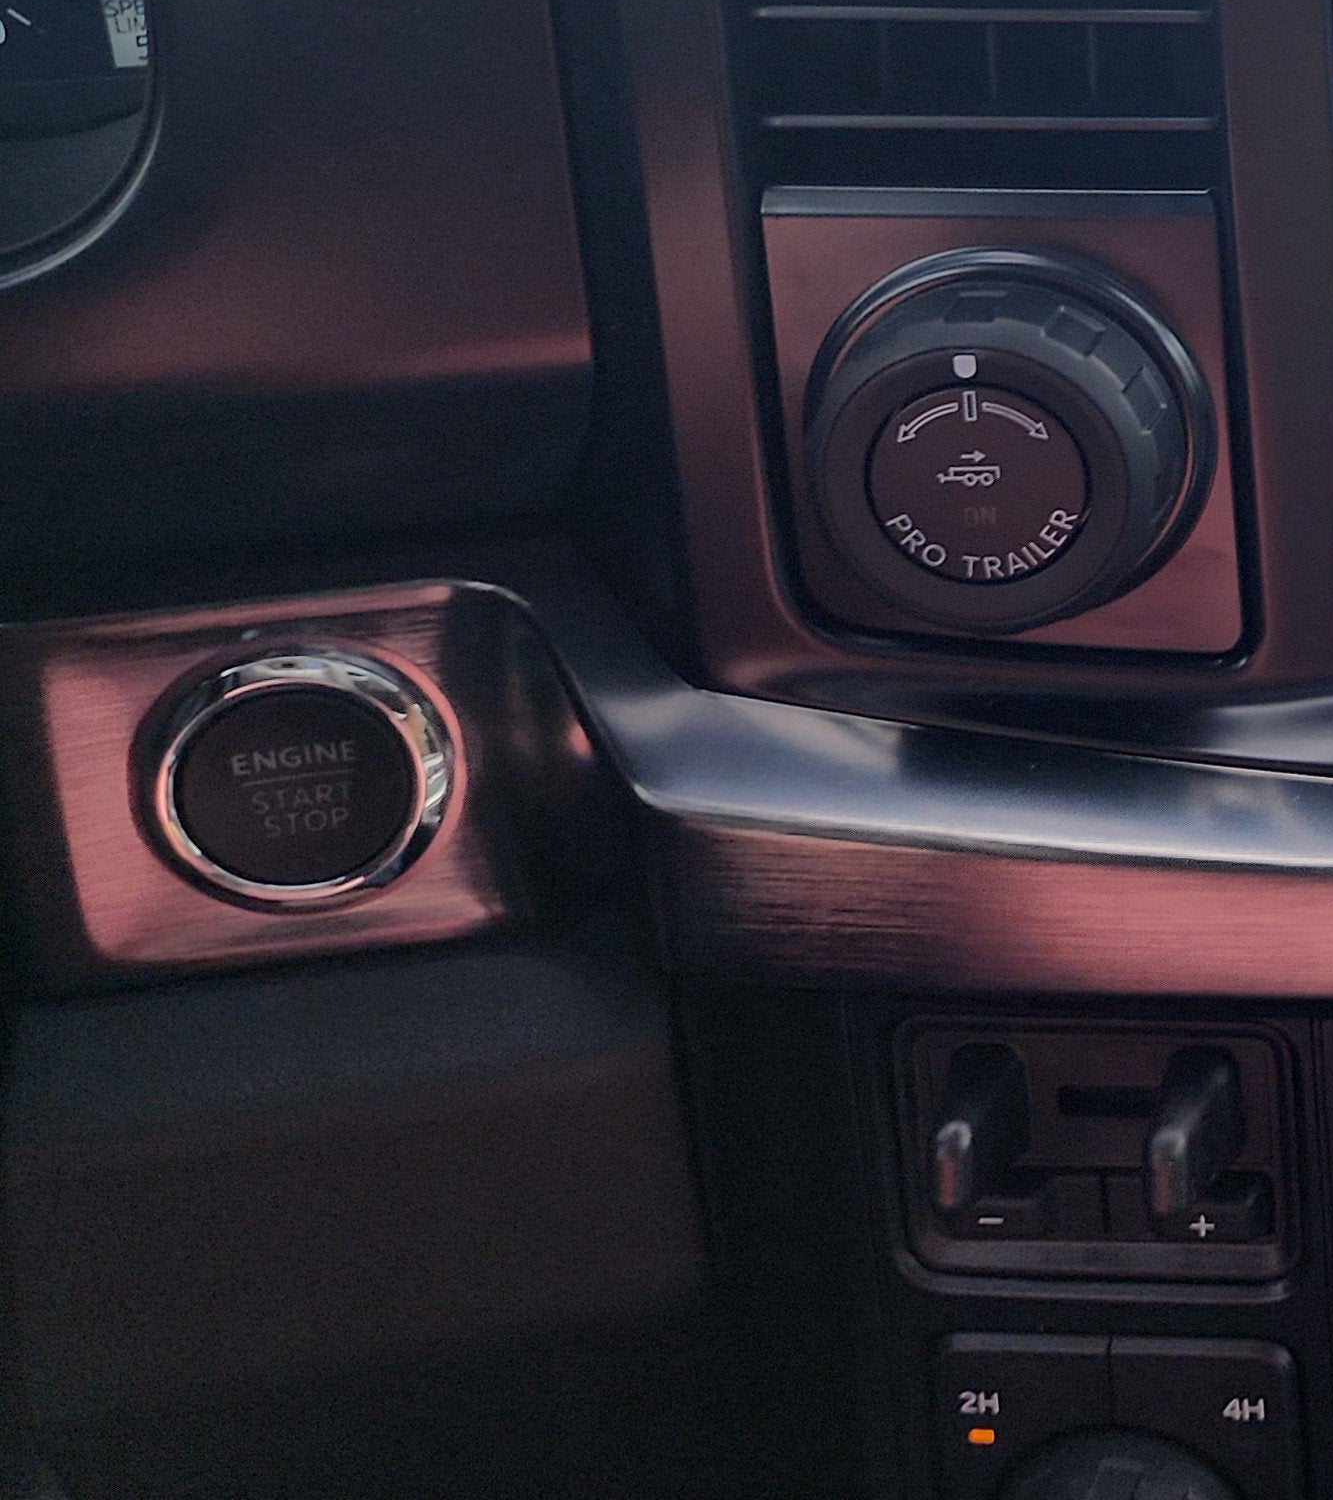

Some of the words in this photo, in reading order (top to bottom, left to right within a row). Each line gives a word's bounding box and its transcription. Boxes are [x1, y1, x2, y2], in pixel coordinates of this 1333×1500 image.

[885, 513, 948, 568] PRO
[961, 508, 1080, 580] TRAILER
[231, 739, 358, 777] ENGINE
[251, 780, 354, 815] START
[263, 806, 349, 840] STOP
[957, 1391, 1001, 1416] 2H
[1222, 1398, 1266, 1422] 4H
